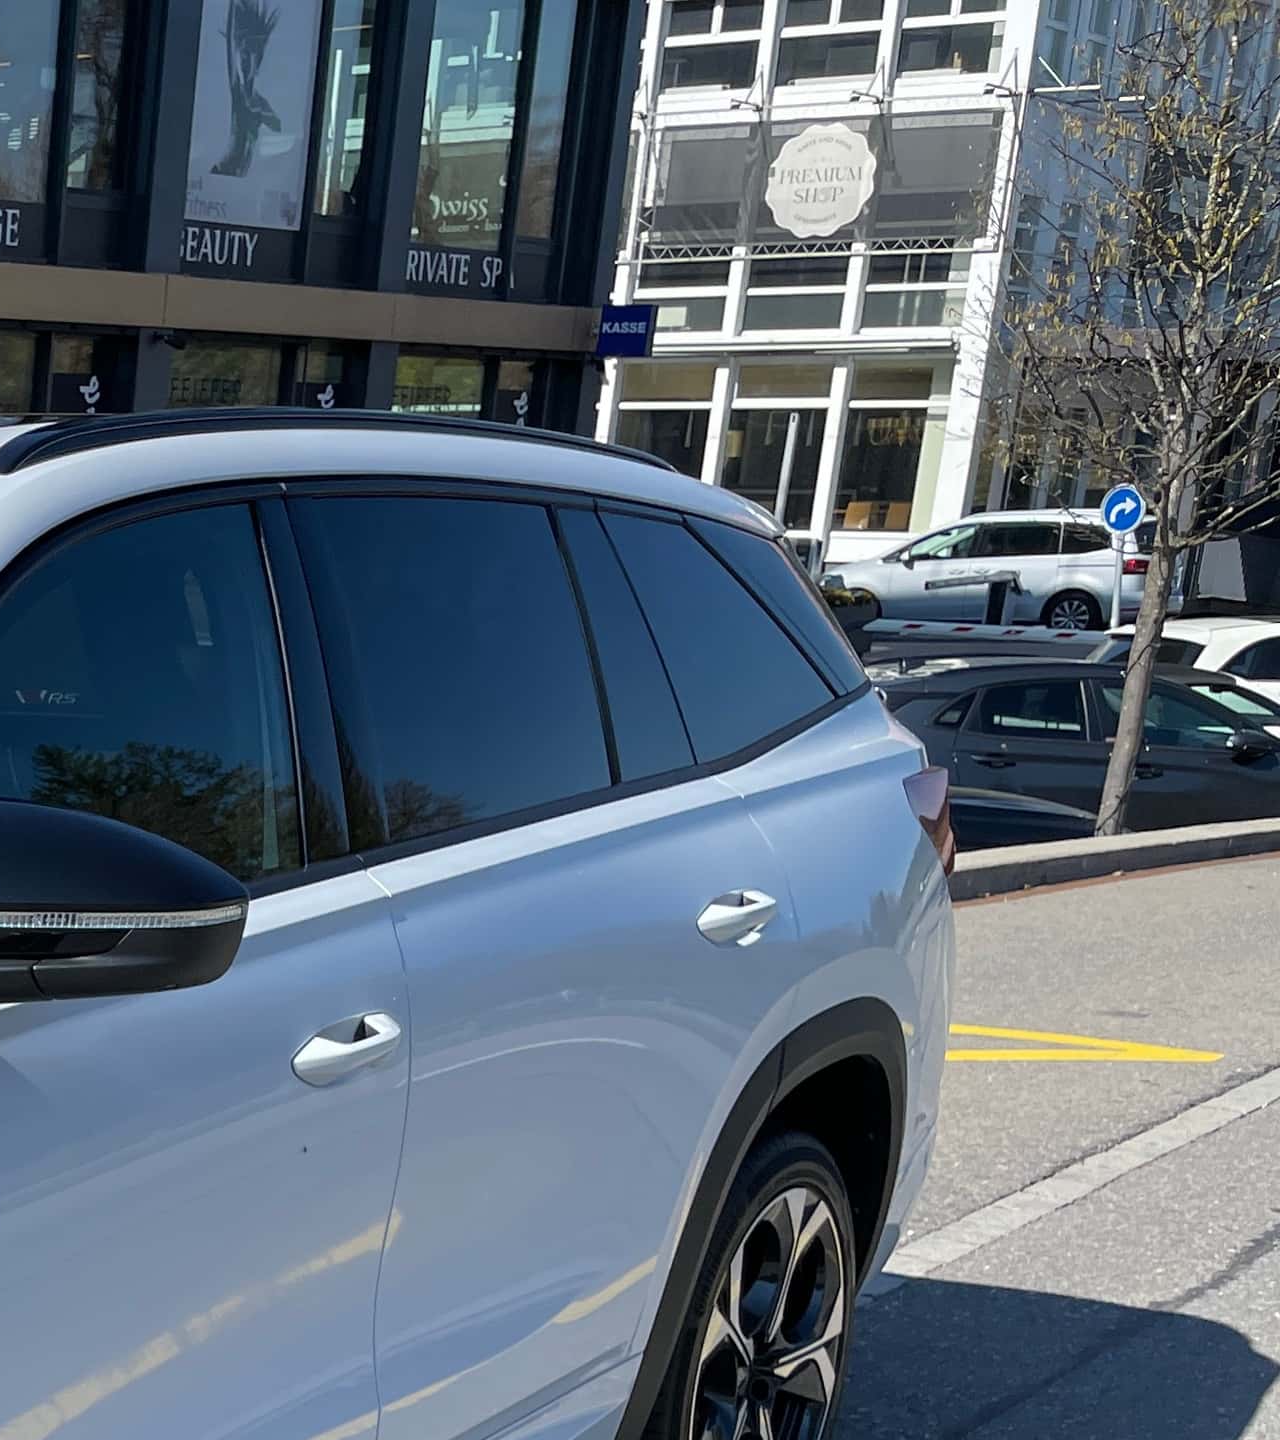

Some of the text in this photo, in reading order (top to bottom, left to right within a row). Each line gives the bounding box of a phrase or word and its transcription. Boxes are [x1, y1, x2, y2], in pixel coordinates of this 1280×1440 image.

[780, 166, 862, 184] PREMIUM
[793, 187, 844, 203] SHOP
[180, 226, 258, 267] EAUTY
[480, 256, 514, 289] SP
[602, 321, 647, 334] KASSE
